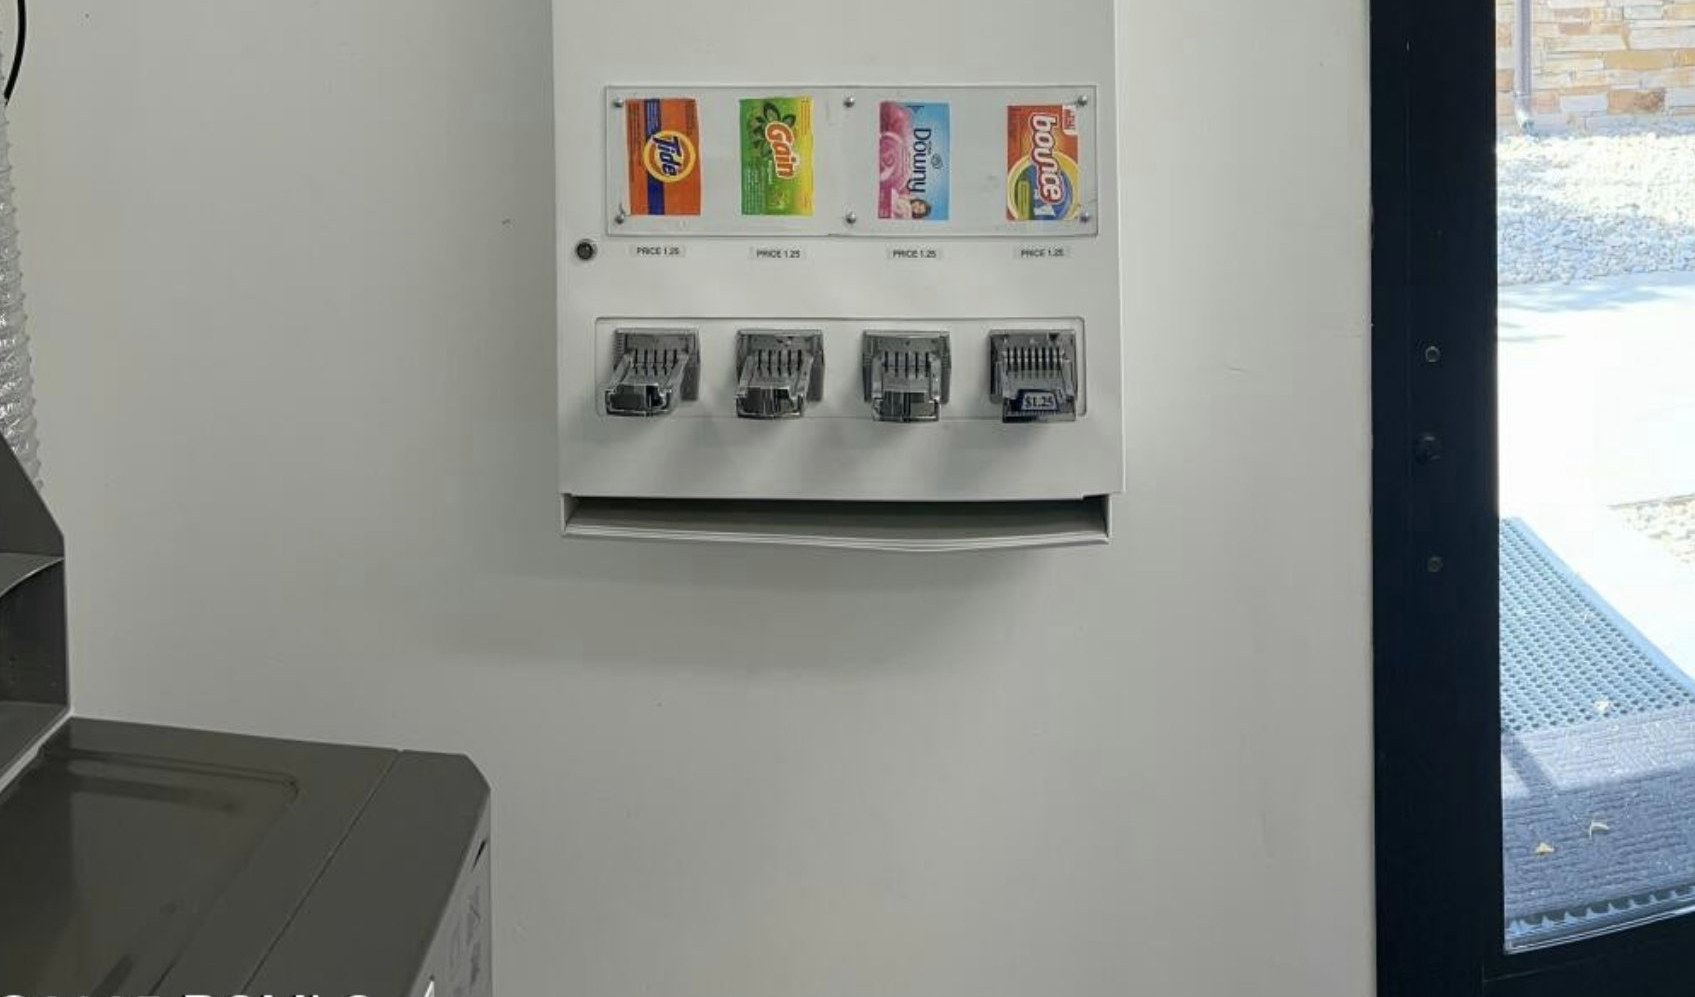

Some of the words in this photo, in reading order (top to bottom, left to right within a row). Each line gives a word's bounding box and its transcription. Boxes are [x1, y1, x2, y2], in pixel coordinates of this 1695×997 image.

[652, 135, 682, 176] Tide
[765, 122, 796, 178] Gain
[907, 128, 931, 193] Downy
[1029, 113, 1065, 204] bounce
[636, 246, 662, 256] PRICE
[756, 250, 782, 259] PRICE
[893, 250, 918, 259] PRICE
